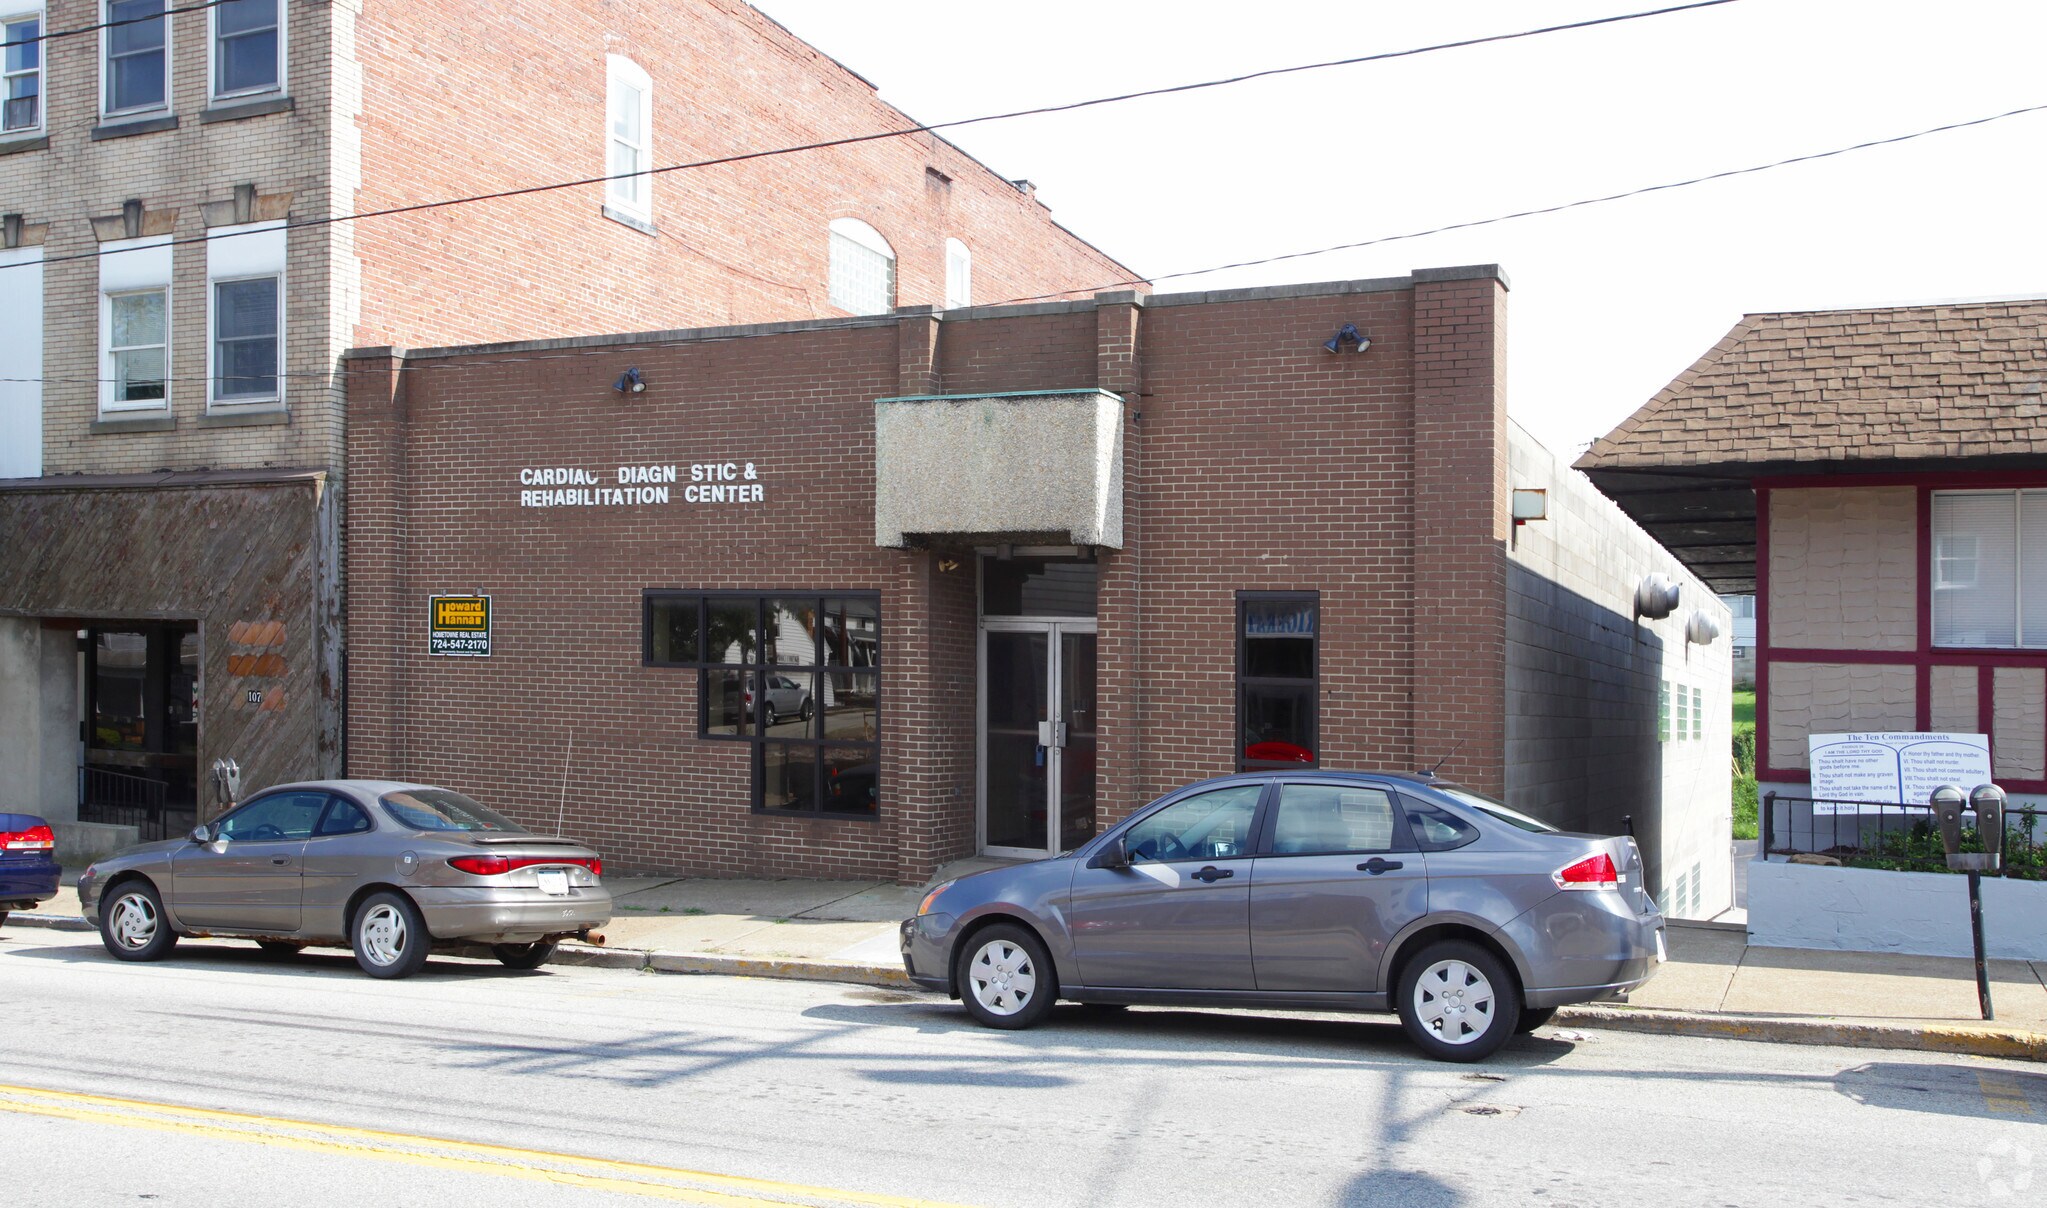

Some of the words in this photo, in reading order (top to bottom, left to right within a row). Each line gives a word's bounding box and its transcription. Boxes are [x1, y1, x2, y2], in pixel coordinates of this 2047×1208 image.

[744, 462, 757, 480] &
[520, 486, 669, 507] REHABILITATION
[684, 484, 764, 503] CENTER
[438, 602, 482, 613] Howard
[432, 639, 488, 650] 724-547-2170
[248, 691, 261, 702] 107
